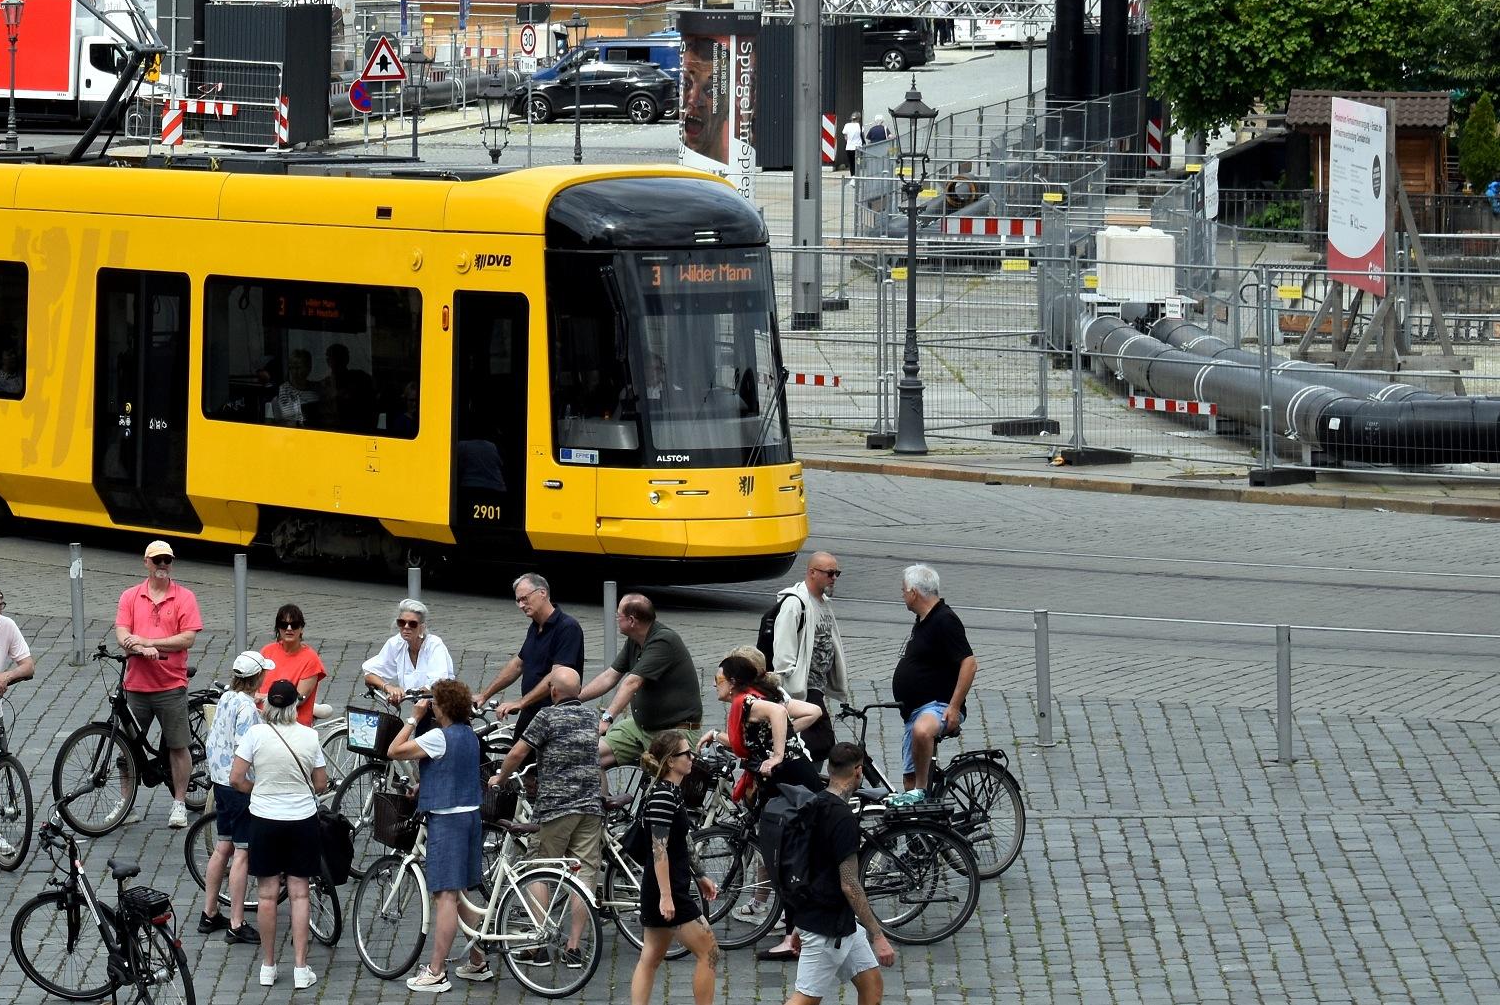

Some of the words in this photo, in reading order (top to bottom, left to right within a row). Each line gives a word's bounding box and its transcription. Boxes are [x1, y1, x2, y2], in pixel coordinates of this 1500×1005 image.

[523, 34, 533, 46] 30
[736, 41, 753, 116] Spiegel
[737, 145, 752, 199] Spieg
[486, 254, 512, 267] DVB
[652, 265, 661, 286] 3
[680, 263, 717, 282] Wilder
[719, 263, 752, 281] Mann
[473, 505, 501, 520] 2901
